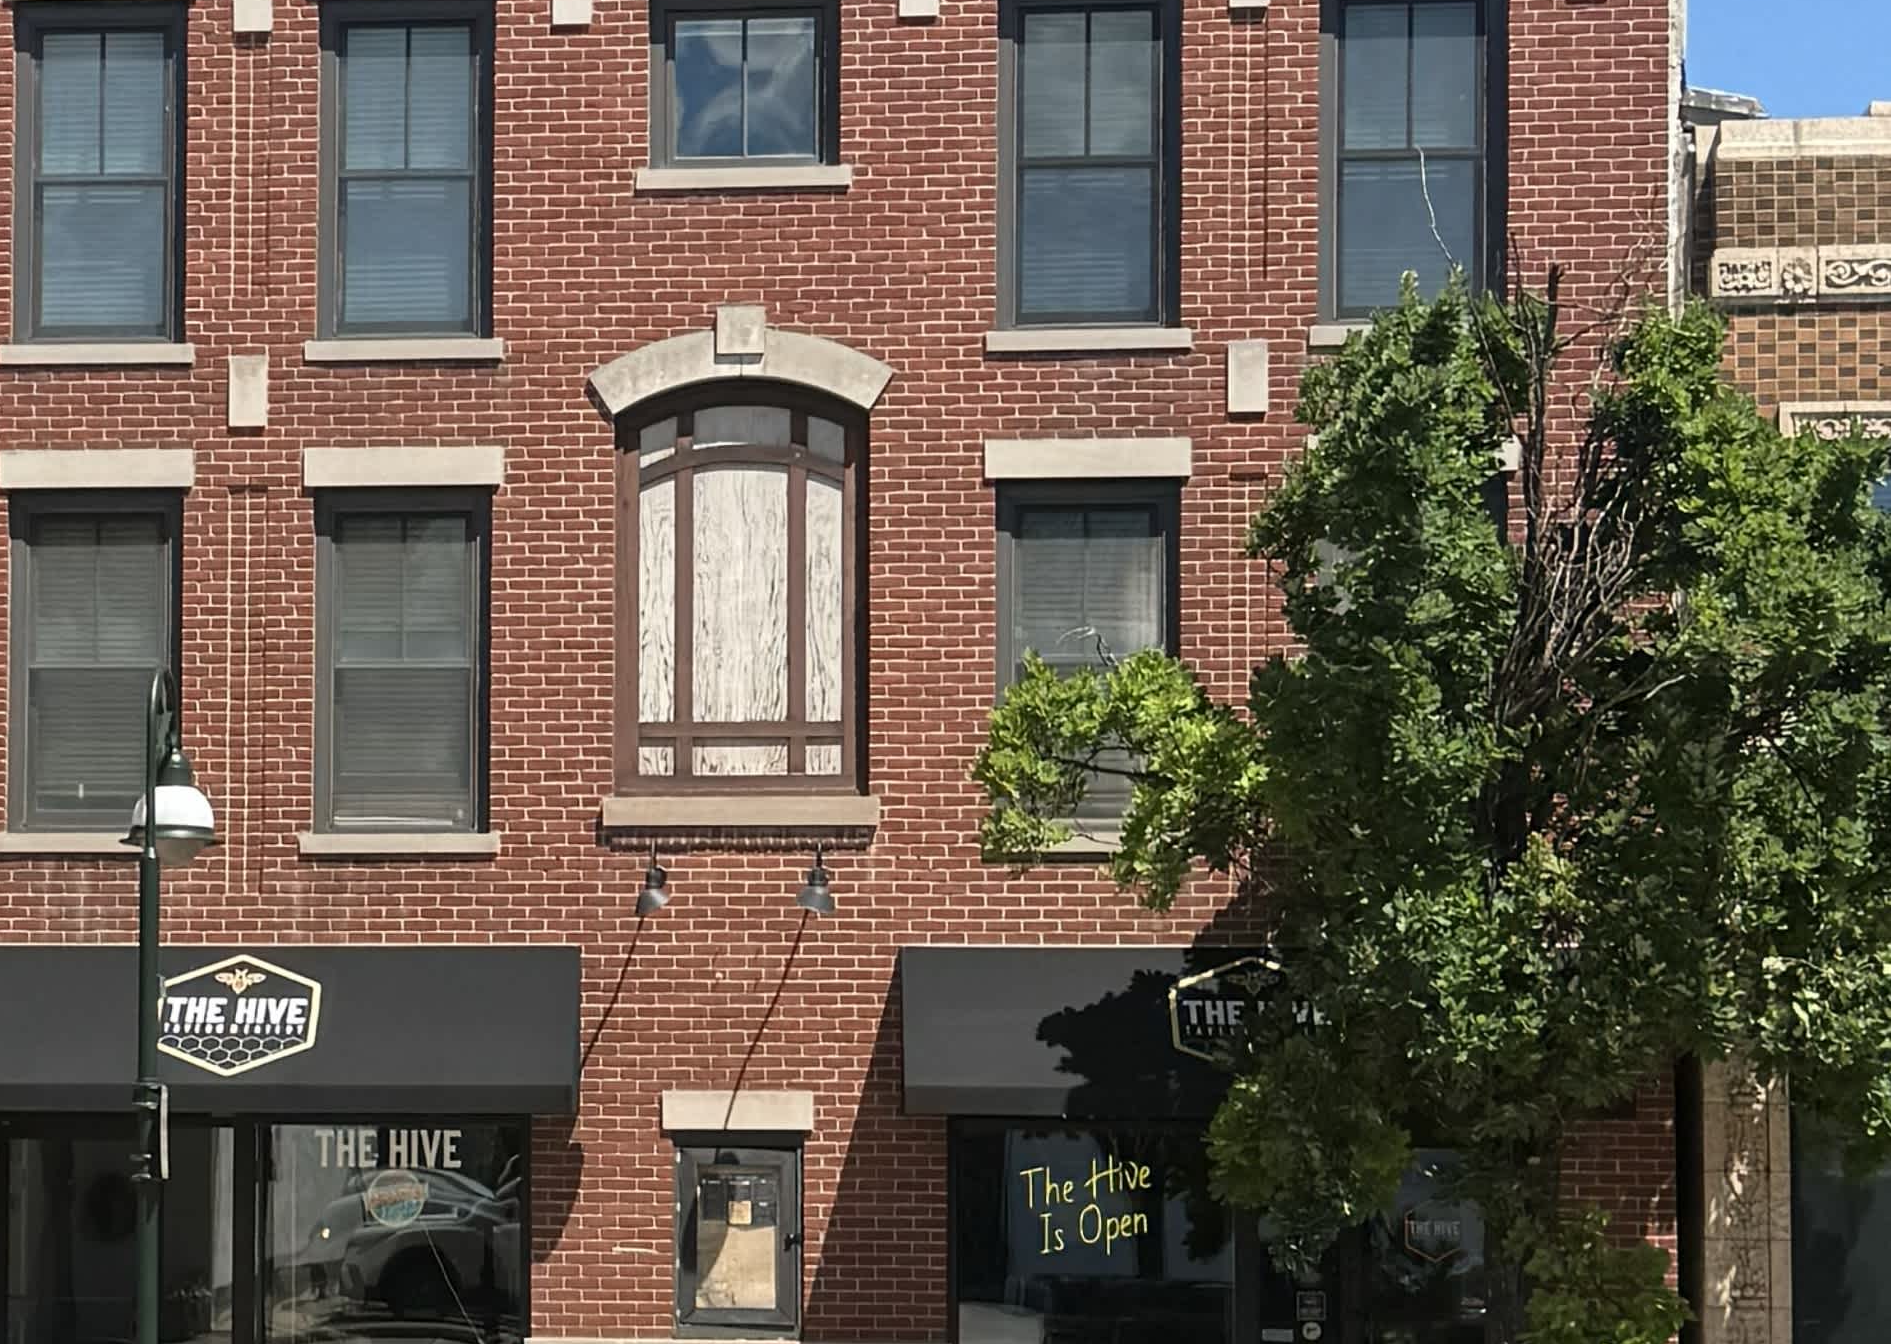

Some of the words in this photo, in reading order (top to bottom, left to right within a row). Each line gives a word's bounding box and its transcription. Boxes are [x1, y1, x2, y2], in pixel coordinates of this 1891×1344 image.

[166, 996, 228, 1024] THE
[234, 997, 308, 1025] HIVE
[1181, 1000, 1244, 1026] THE
[314, 1129, 379, 1168] THE
[389, 1129, 462, 1168] HIVE
[1019, 1165, 1075, 1209] The
[1083, 1153, 1153, 1201] Hive
[1039, 1212, 1065, 1255] Is
[1079, 1203, 1148, 1257] Open
